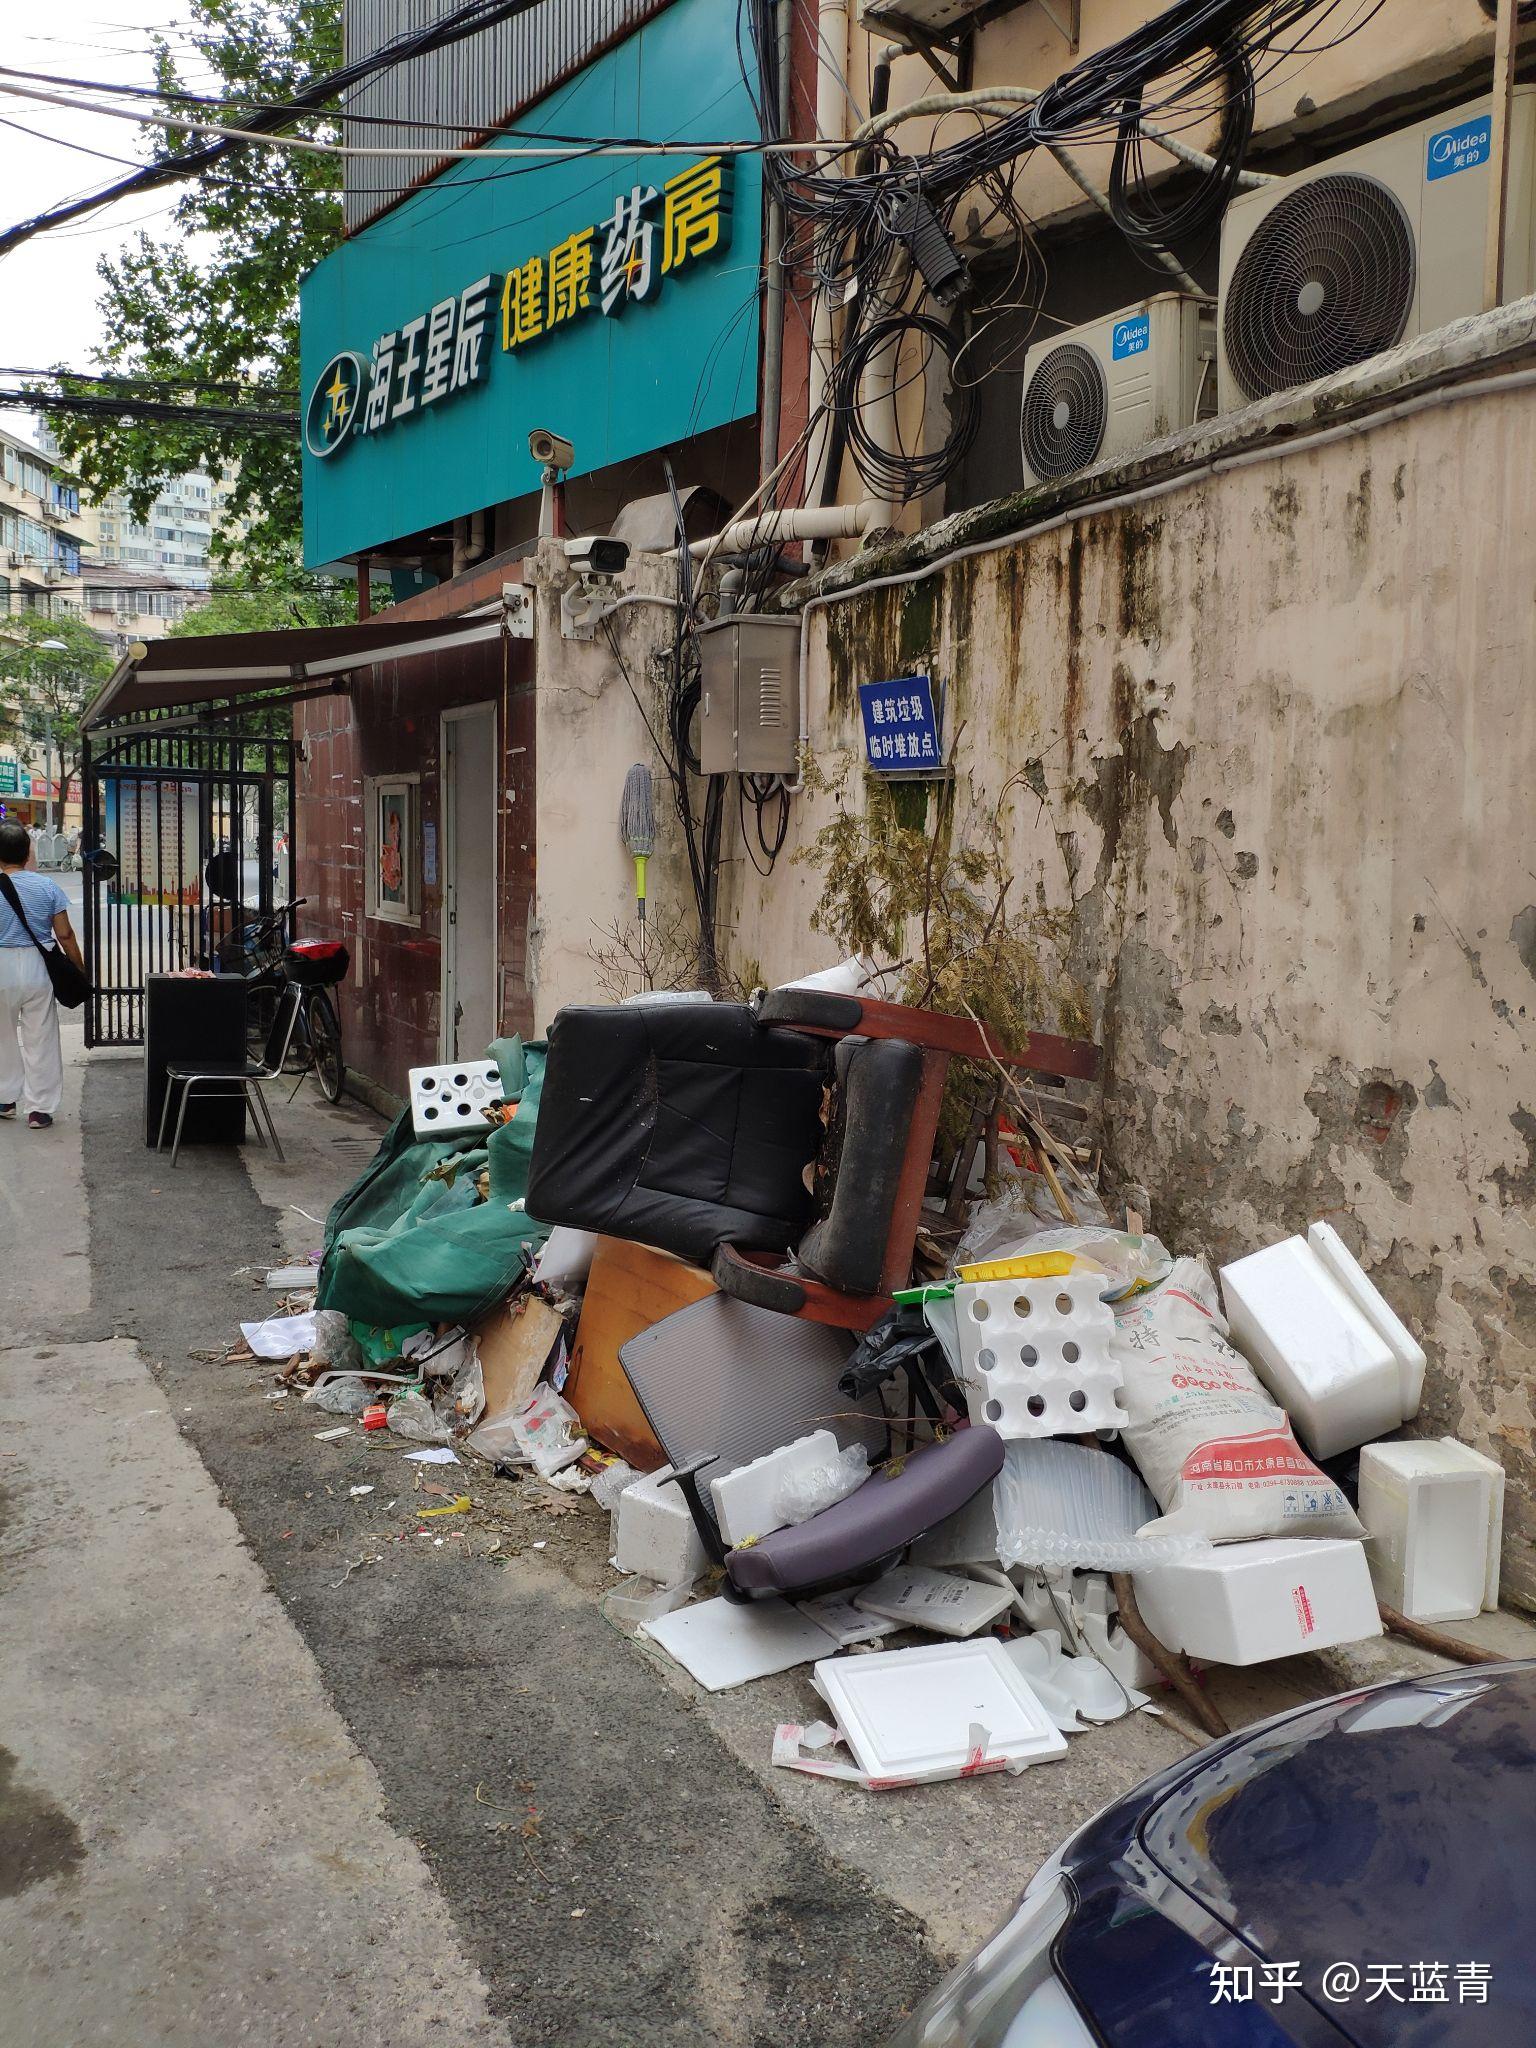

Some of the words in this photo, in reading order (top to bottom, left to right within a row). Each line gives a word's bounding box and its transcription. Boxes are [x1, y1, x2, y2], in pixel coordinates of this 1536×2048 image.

[1433, 132, 1487, 162] Midea
[1453, 149, 1479, 170] 美的
[1115, 325, 1148, 347] Midea
[1128, 339, 1144, 353] 美的
[871, 695, 925, 725] 建筑垃圾
[869, 731, 935, 759] 临时堆放点
